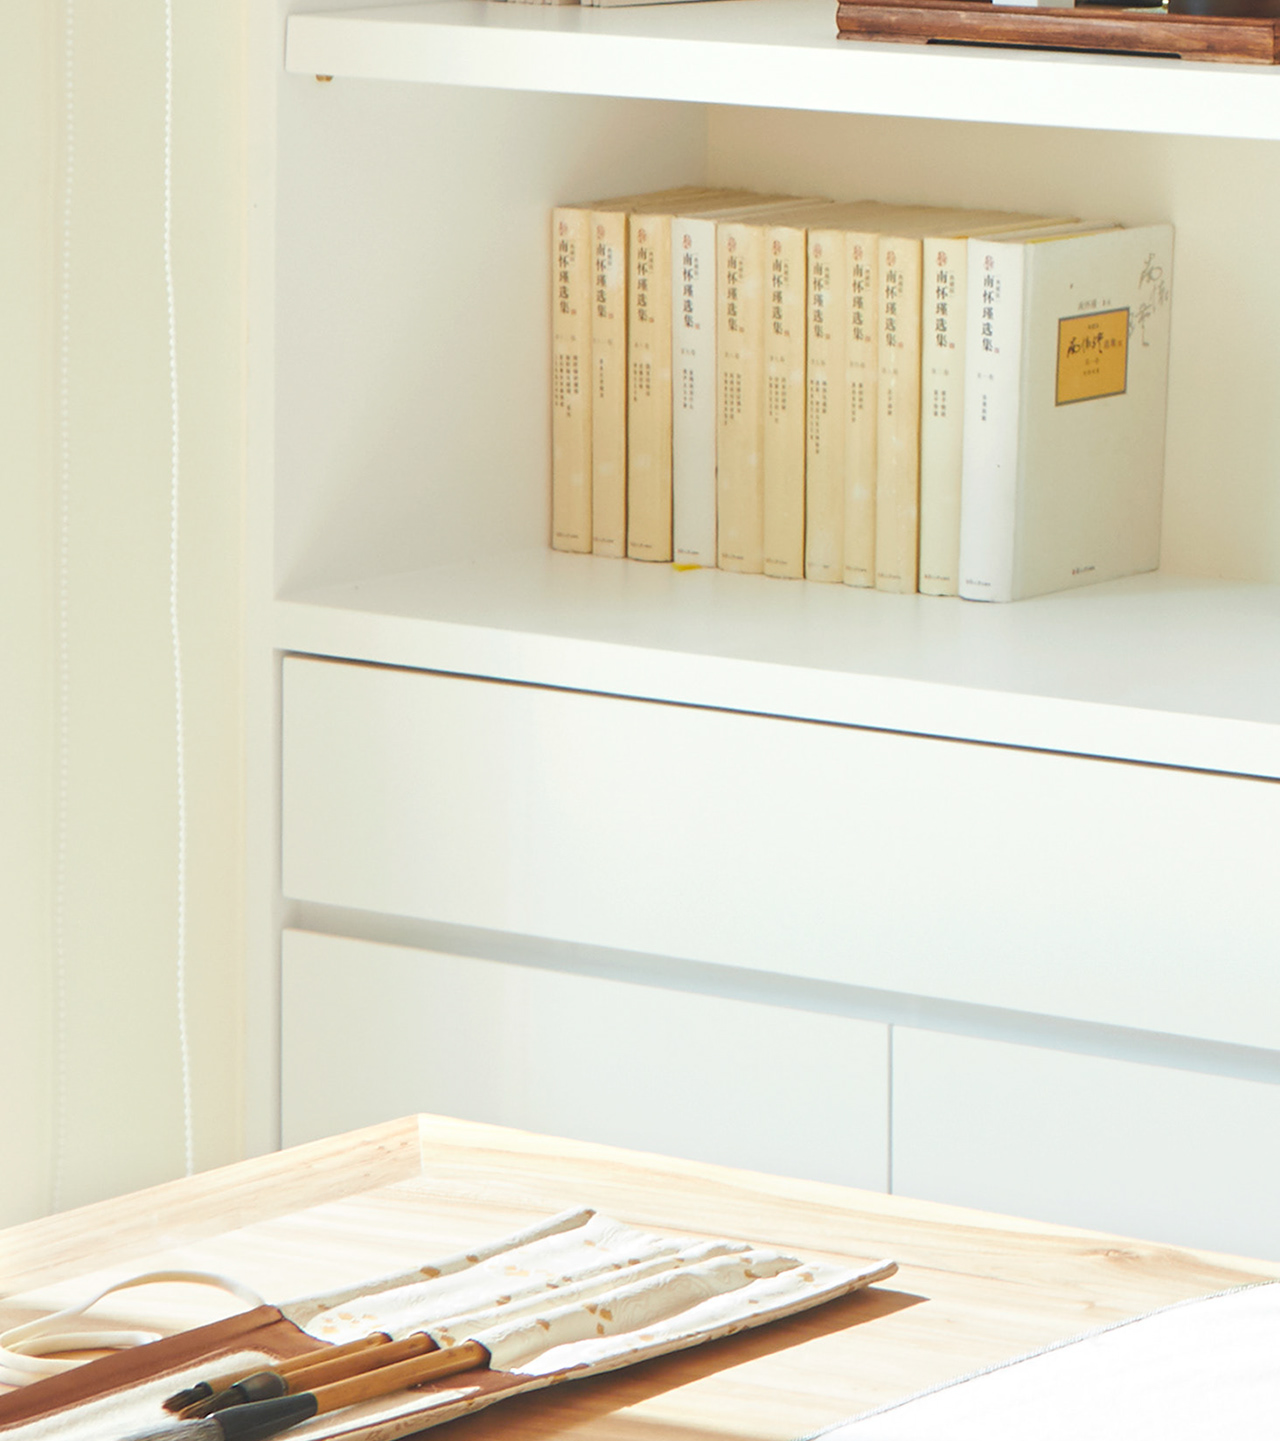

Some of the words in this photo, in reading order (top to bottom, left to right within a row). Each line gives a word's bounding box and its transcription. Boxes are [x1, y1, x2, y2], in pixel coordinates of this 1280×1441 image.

[558, 239, 570, 315] 南怀瑾选集
[596, 243, 607, 318] 南怀瑾选集
[637, 248, 649, 323] 南怀瑾选集
[683, 253, 695, 328] 南怀瑾选集
[727, 256, 739, 332] 南怀瑾选集
[772, 256, 784, 336] 南怀瑾选集
[813, 257, 825, 338] 南怀瑾选集
[852, 262, 866, 343] 南怀瑾选集
[885, 268, 897, 348] 南怀瑾选集
[935, 265, 948, 348] 南怀瑾选集
[981, 273, 994, 354] 南怀瑾选集
